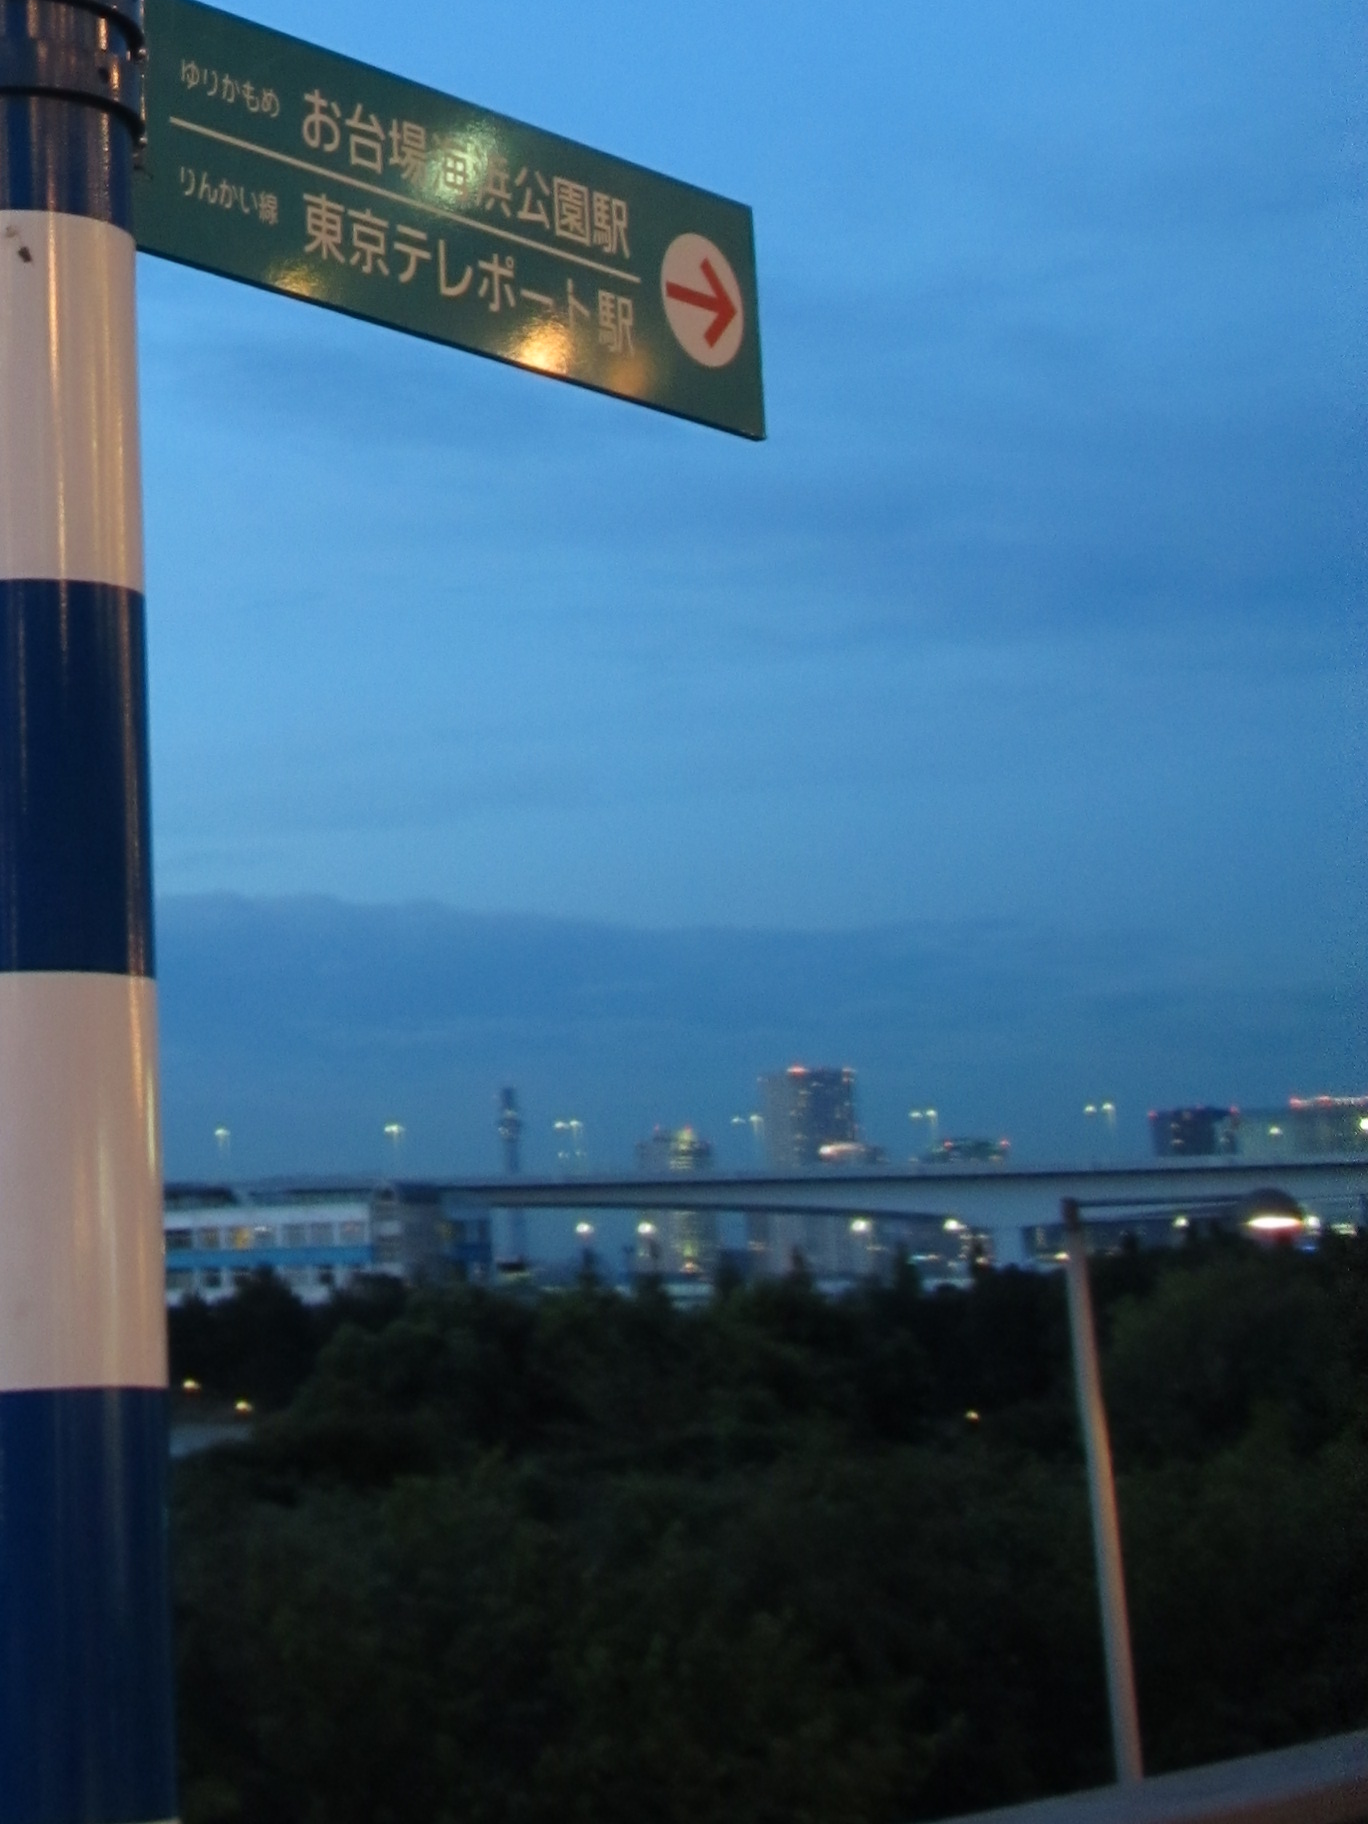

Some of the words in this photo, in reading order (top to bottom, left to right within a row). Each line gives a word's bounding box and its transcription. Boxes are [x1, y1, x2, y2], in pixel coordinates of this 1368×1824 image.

[180, 58, 280, 118] ゆりかもめ
[179, 167, 279, 225] りんかい線
[302, 192, 633, 354] 東京テレポート駅
